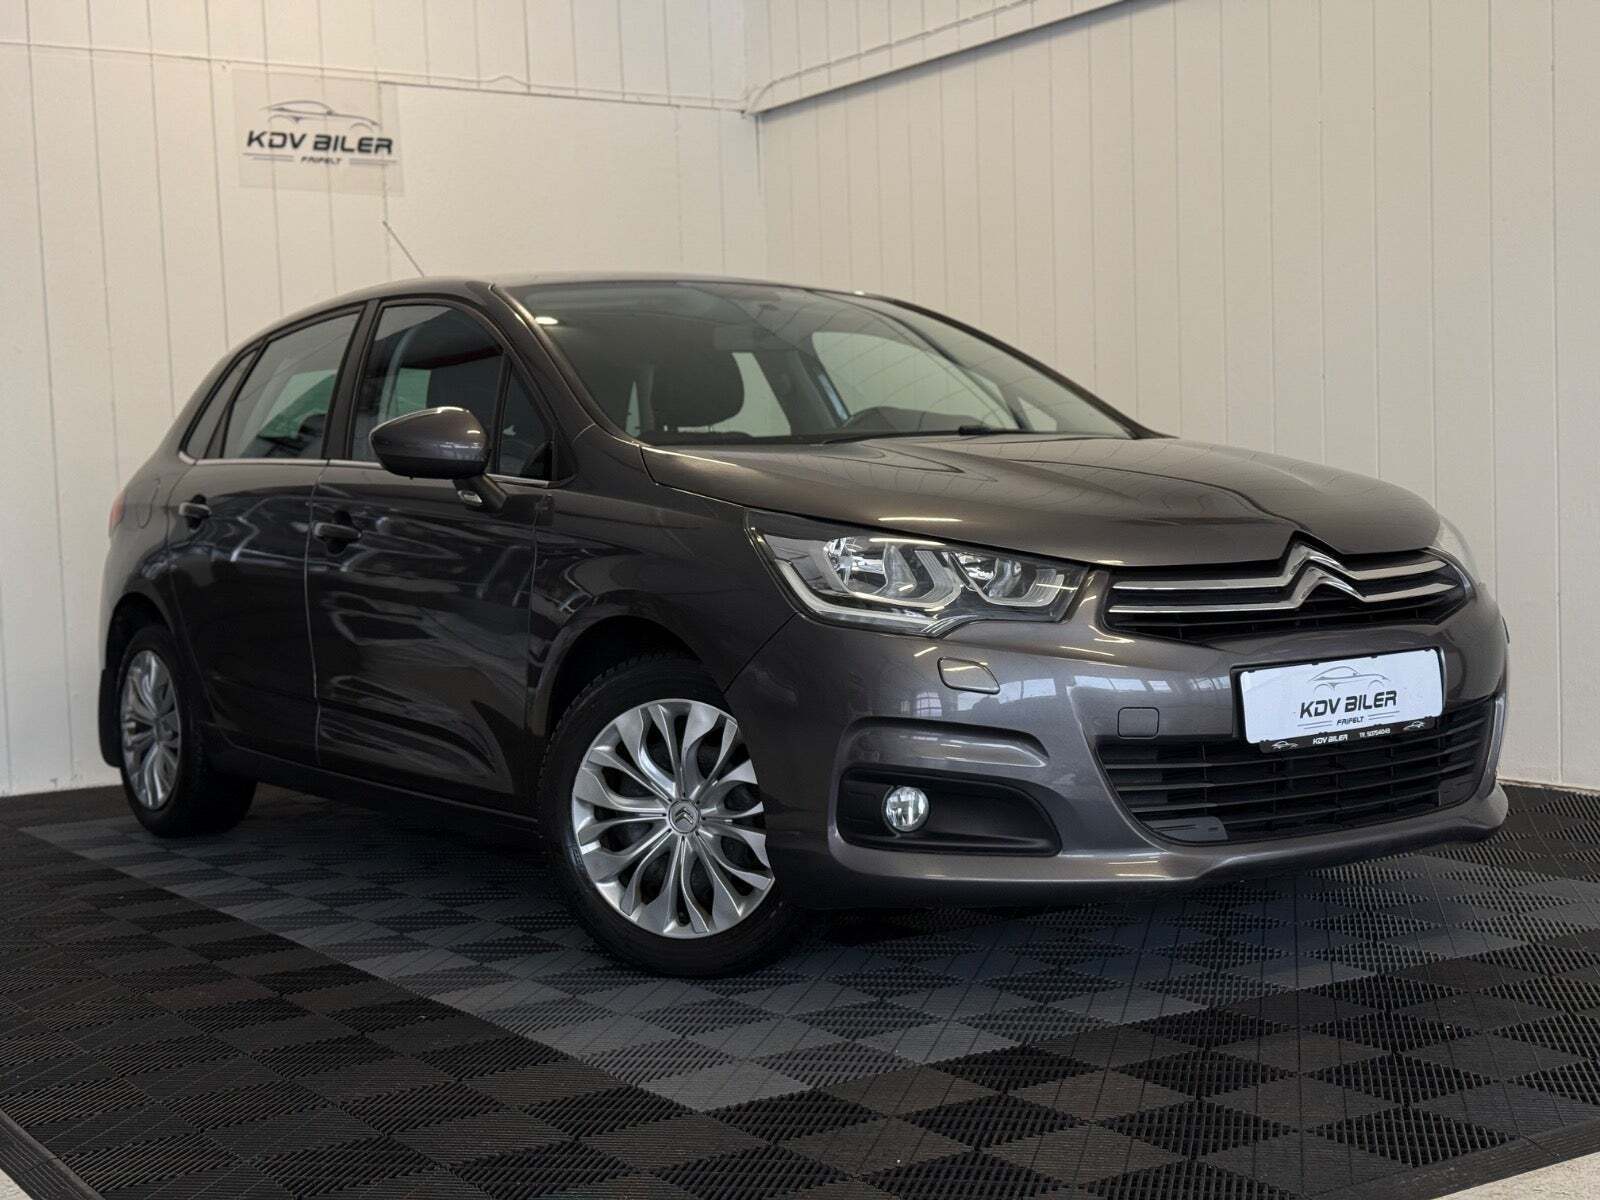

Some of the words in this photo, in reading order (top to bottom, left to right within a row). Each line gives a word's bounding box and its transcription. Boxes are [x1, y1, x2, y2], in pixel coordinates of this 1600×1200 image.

[247, 130, 308, 149] KDV
[313, 133, 394, 155] BILER
[1300, 697, 1341, 718] KDV
[1344, 690, 1397, 712] BILER
[1336, 716, 1365, 726] FRIFELT
[1312, 736, 1328, 745] KDV
[1328, 733, 1348, 744] BILER
